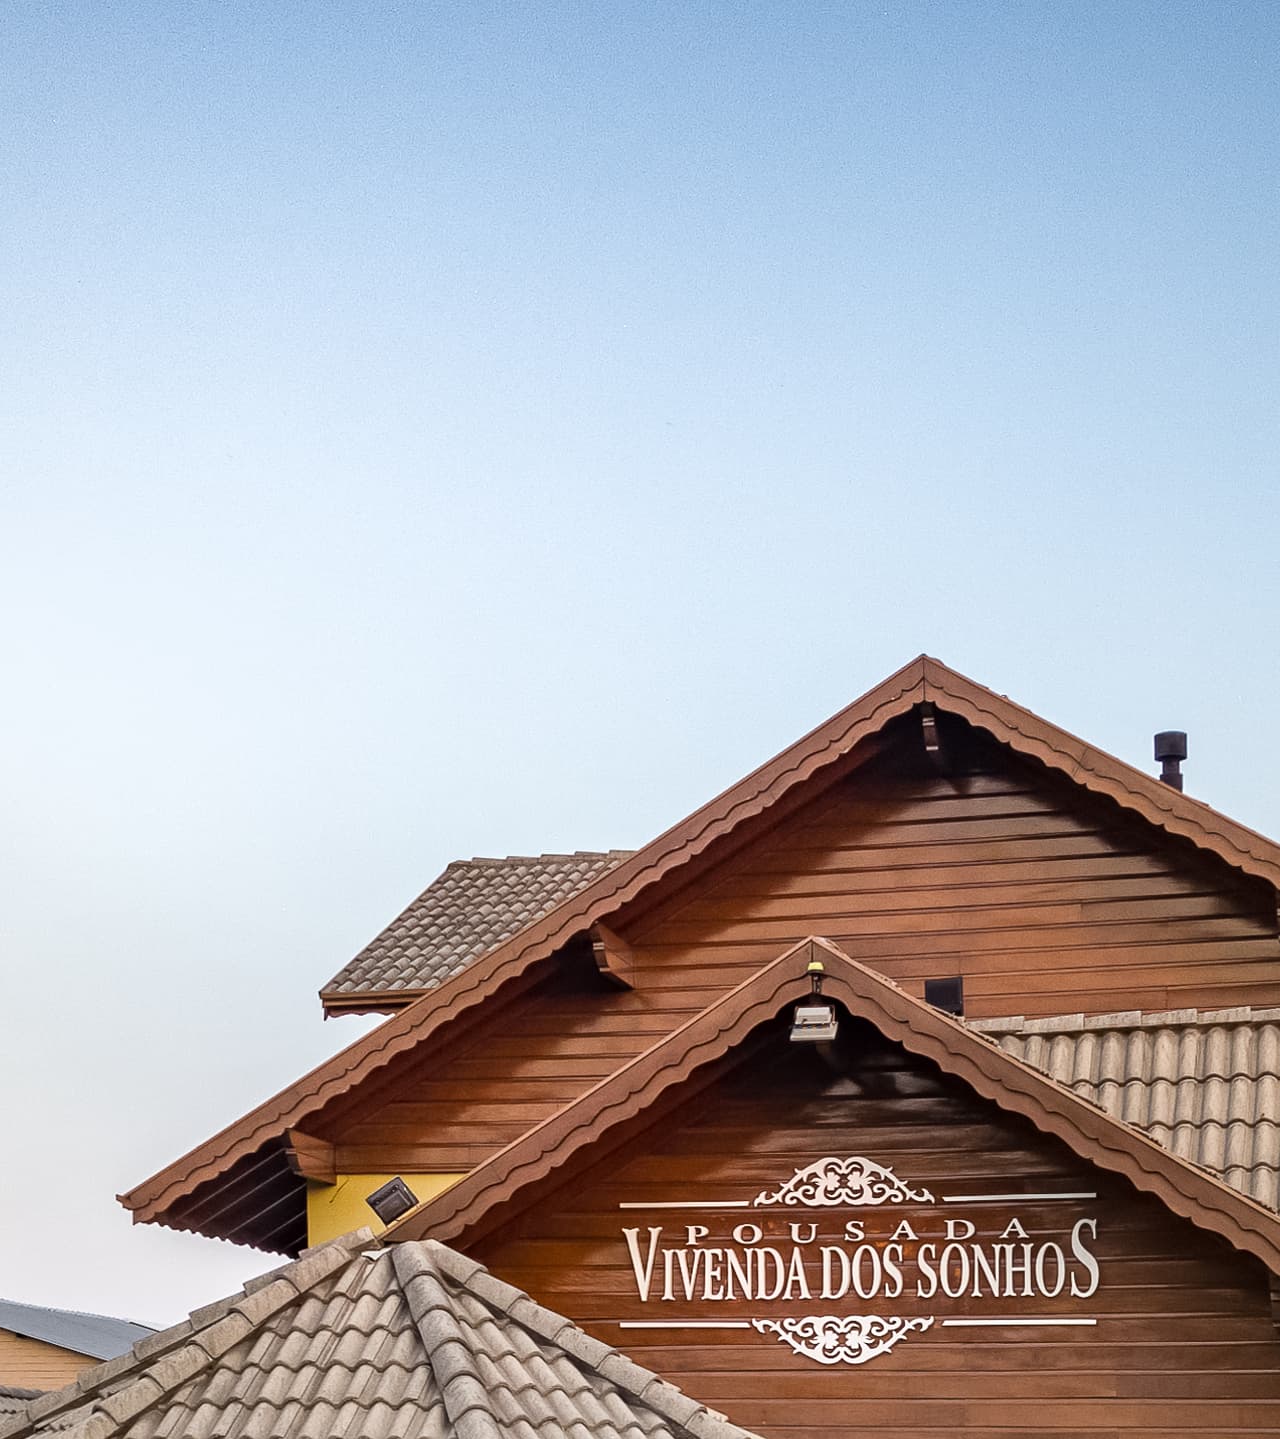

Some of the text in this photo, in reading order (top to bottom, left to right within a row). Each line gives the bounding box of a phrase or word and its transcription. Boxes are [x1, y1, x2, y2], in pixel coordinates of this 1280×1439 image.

[621, 1217, 1100, 1302] VIVENDA DOS SONHOS
[684, 1217, 1030, 1246] POUSADA
